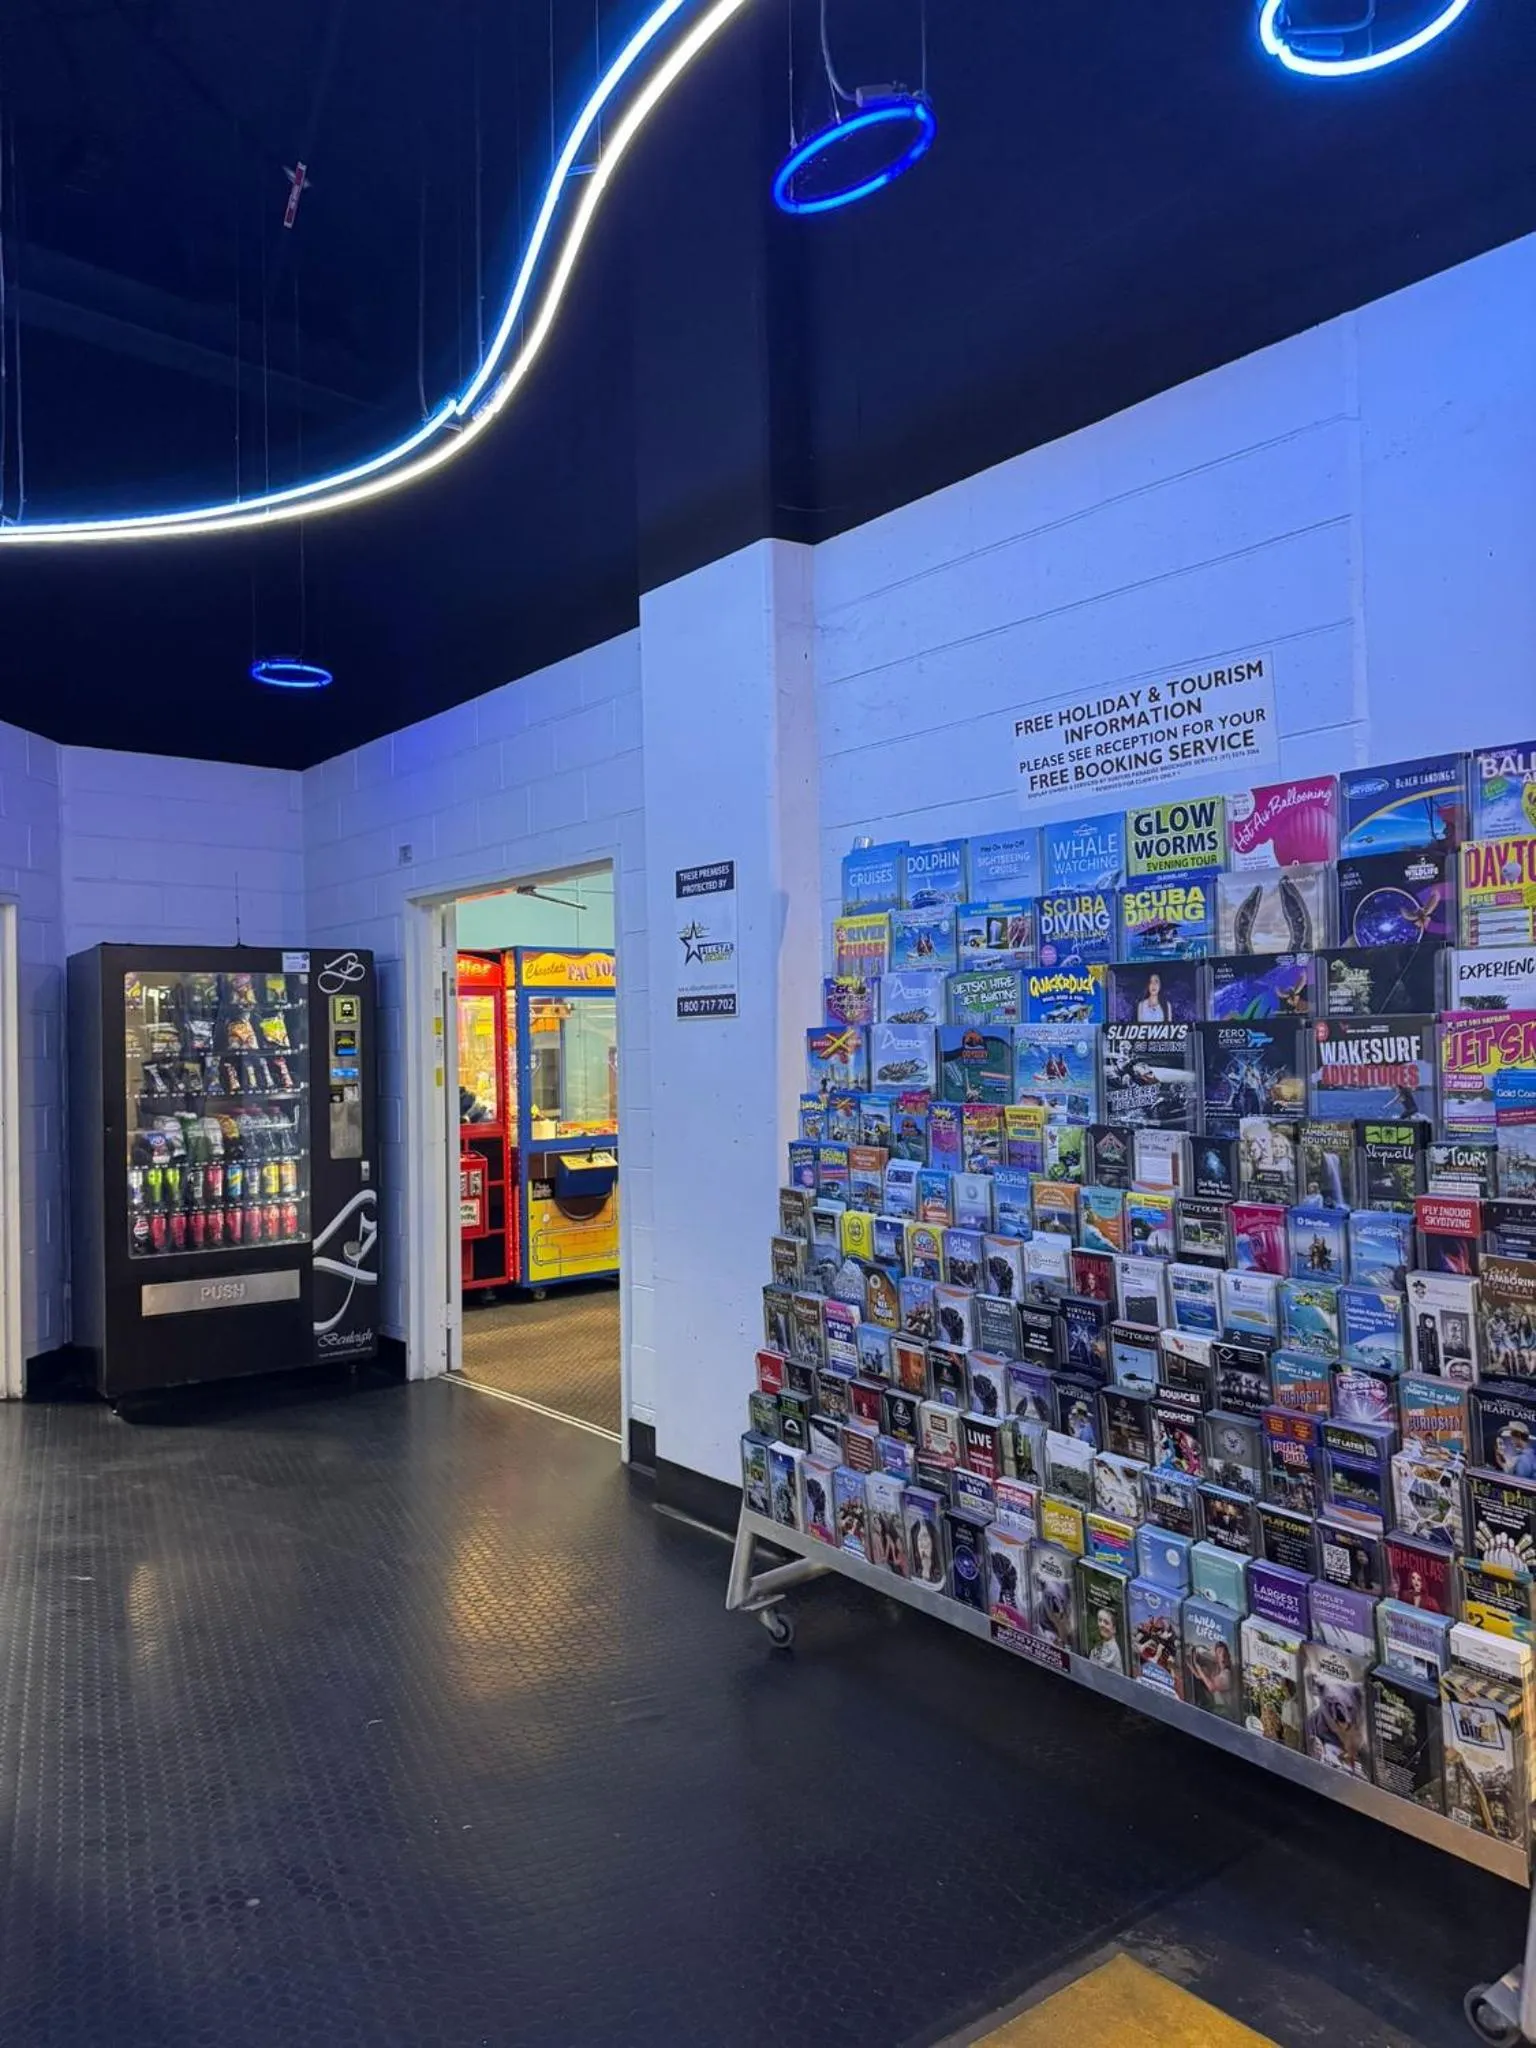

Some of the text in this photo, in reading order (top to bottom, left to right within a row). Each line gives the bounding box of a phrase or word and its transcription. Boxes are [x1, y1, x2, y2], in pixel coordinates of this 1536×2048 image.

[1014, 660, 1264, 737] FREE HOLIDAY & TOURISM
[1064, 697, 1203, 745] INFORMATION
[1019, 708, 1266, 774] PLEASE SEE RECEPTION FOR YOUR
[1029, 730, 1256, 791] FREE BOOKING SERVICE
[1134, 800, 1217, 837] GLOW
[1053, 833, 1118, 861] WHALE
[1134, 830, 1219, 860] WORMS
[907, 850, 960, 873] DOLPHIN
[1054, 854, 1119, 875] WATCHING
[1146, 854, 1218, 872] EVENING TOUR
[682, 880, 718, 894] PROTECTED
[849, 868, 894, 887] CRUISES
[1042, 894, 1107, 917] SCUBA
[1124, 885, 1205, 910] SCUBA
[1041, 910, 1111, 935] DIVING
[1125, 902, 1205, 927] DIVING
[700, 1000, 716, 1011] 717
[718, 999, 734, 1010] 702
[1107, 1024, 1188, 1040] SLIDEWAYS
[1218, 1028, 1246, 1039] ZERO
[1319, 1035, 1421, 1066] WAKESURF
[1321, 1064, 1419, 1088] ADVENTURES
[1424, 1216, 1471, 1229] SKYDIVING
[1440, 1206, 1472, 1218] INDOOR
[201, 1283, 245, 1301] PUSH
[967, 1429, 993, 1449] LIVE
[1253, 1583, 1299, 1606] LARGEST
